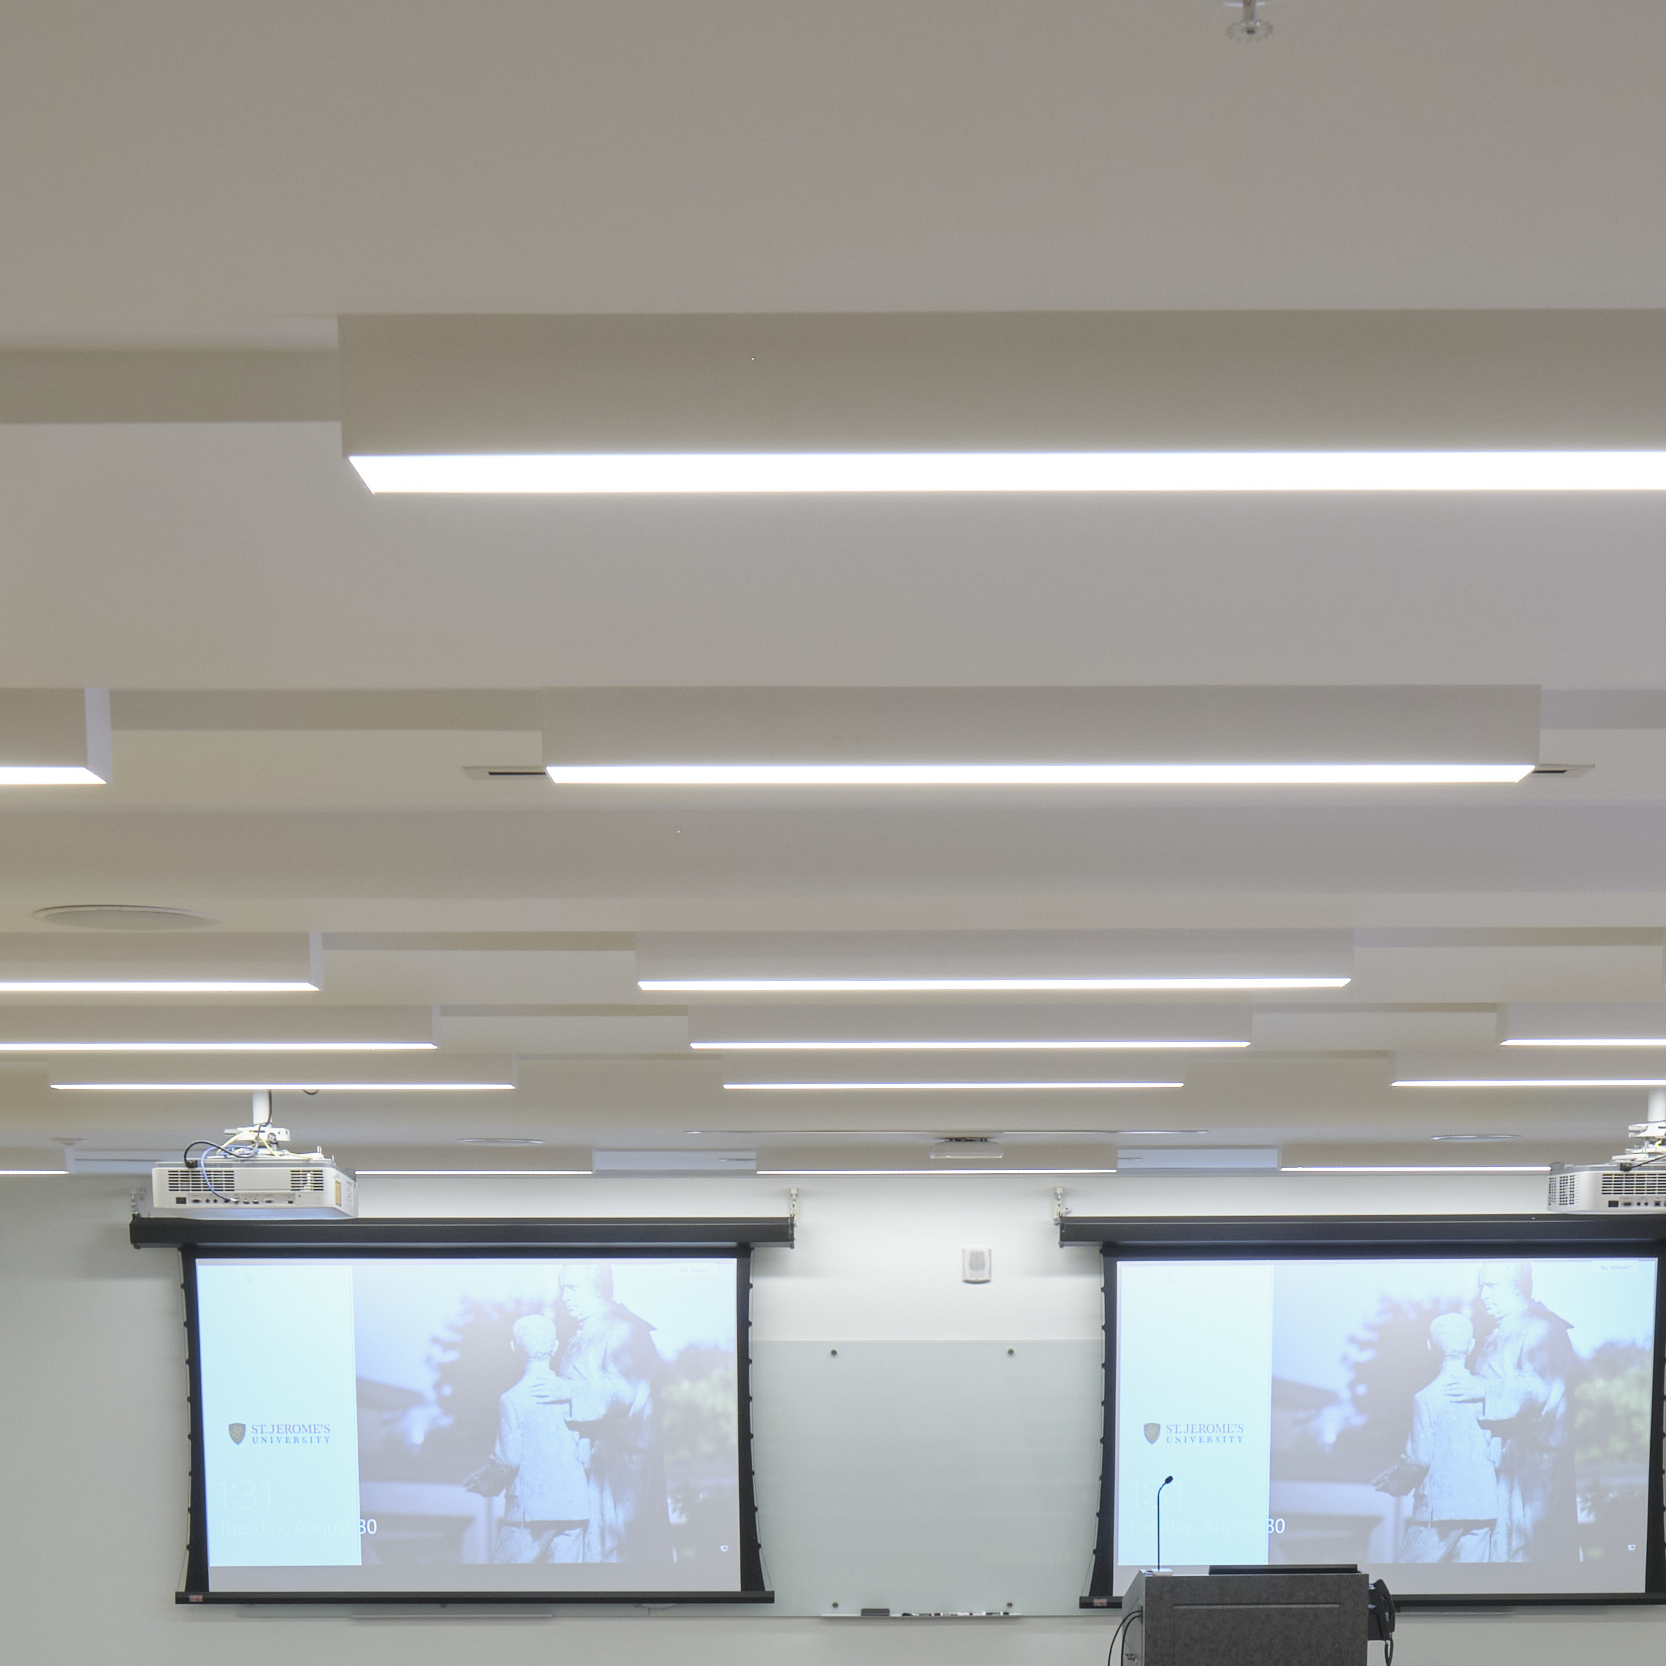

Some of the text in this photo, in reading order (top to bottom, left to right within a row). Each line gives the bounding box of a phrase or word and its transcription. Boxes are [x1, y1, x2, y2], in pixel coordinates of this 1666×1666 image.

[251, 1436, 331, 1444] UNIVERSITY
[1166, 1435, 1244, 1444] UNIVERSITY
[216, 1479, 272, 1510] 1:31
[294, 1520, 352, 1538] August
[359, 1518, 378, 1535] 30
[1202, 1519, 1261, 1538] August
